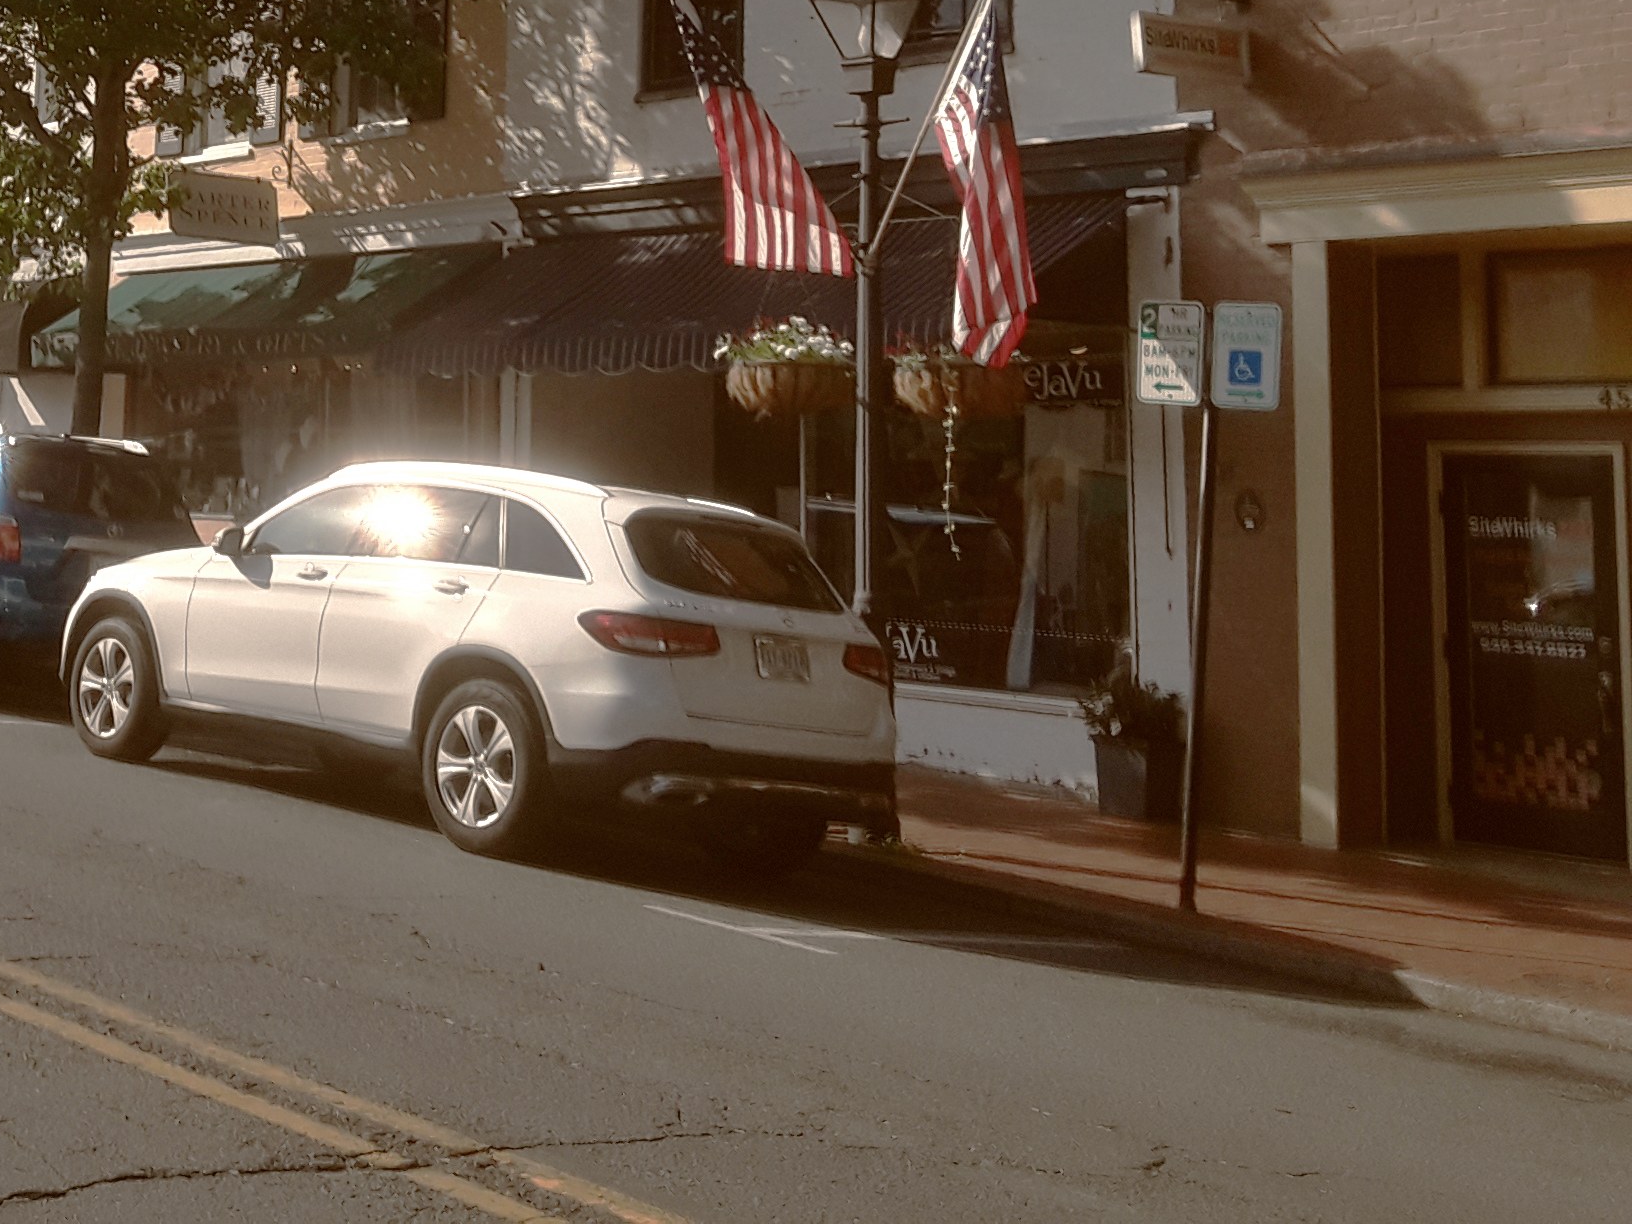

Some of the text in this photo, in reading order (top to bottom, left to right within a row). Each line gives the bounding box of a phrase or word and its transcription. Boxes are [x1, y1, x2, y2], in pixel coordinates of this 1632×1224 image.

[178, 188, 272, 212] ARTER
[1141, 309, 1157, 334] 2
[1023, 360, 1103, 401] eJaVu
[1469, 515, 1557, 541] SiteWhirks
